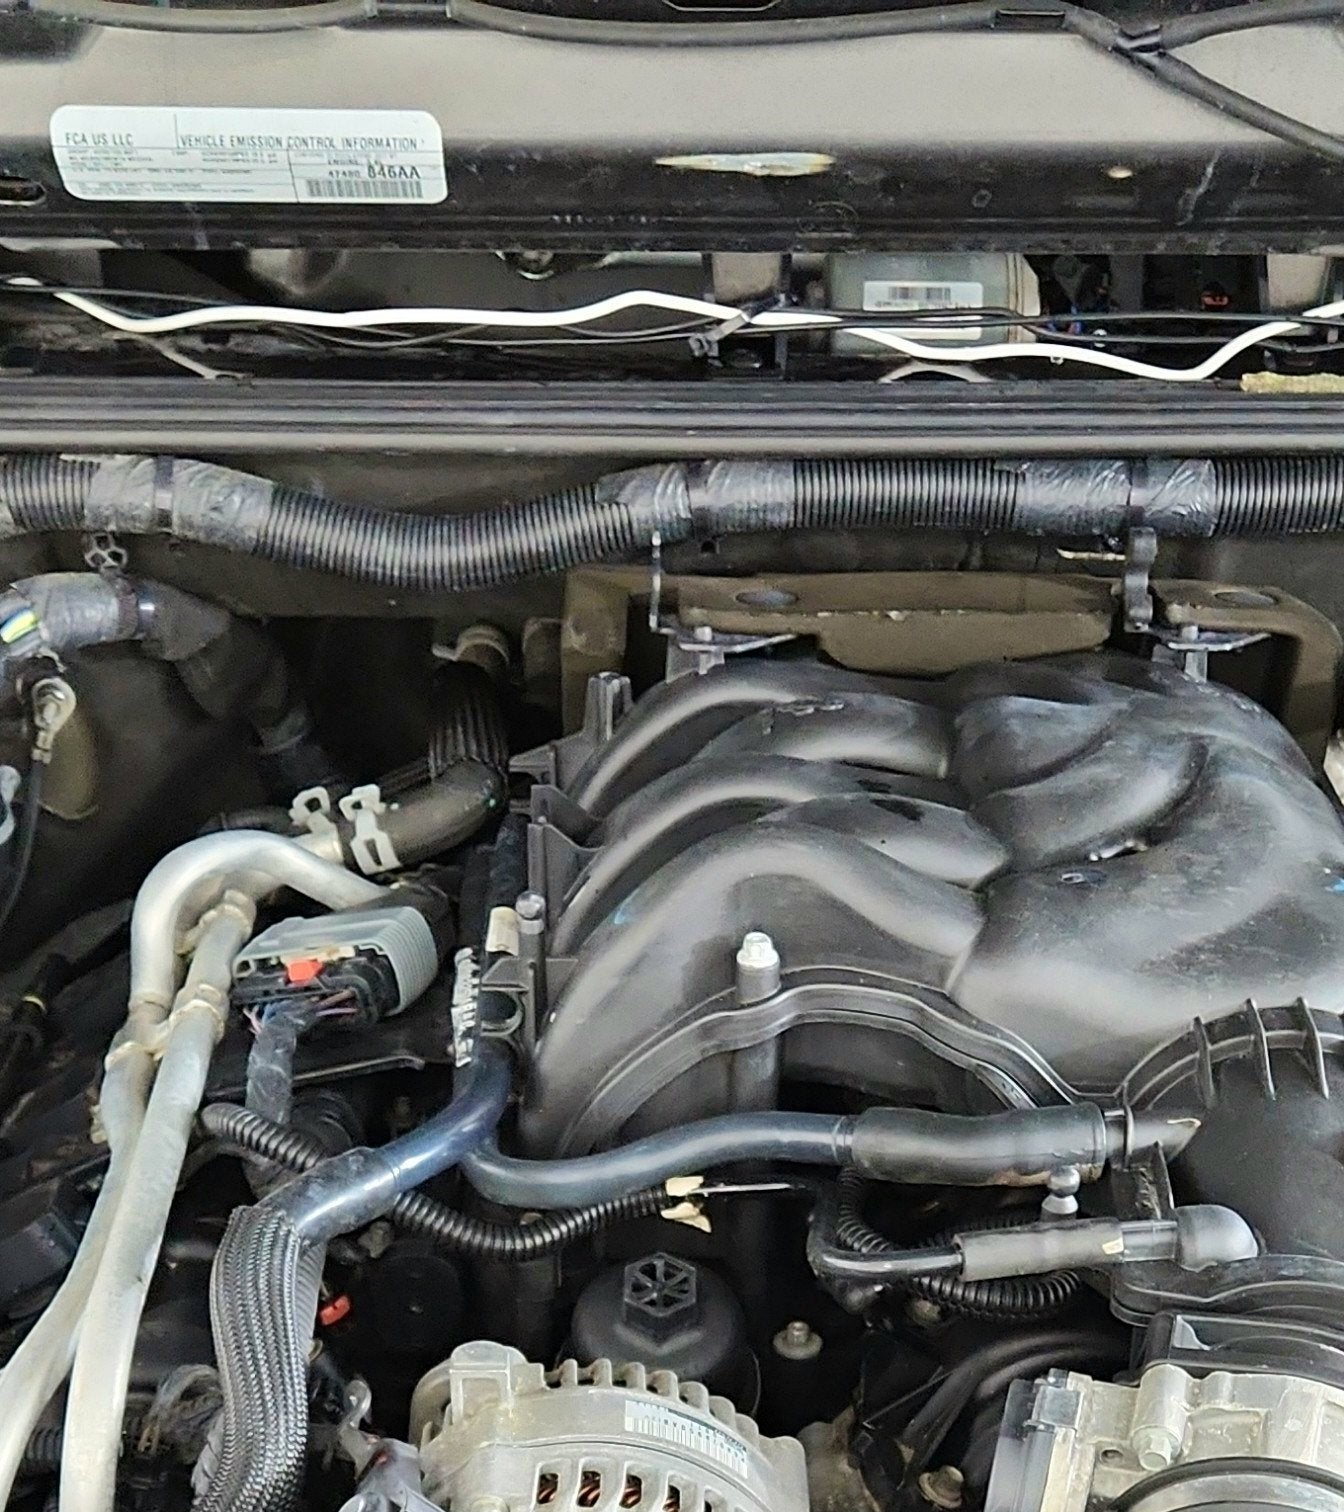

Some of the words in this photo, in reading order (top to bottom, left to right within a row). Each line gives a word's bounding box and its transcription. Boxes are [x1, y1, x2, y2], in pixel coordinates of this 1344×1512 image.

[65, 132, 88, 146] FCA
[92, 133, 108, 147] US
[112, 133, 133, 147] LLC
[180, 135, 224, 148] VEHICLE
[230, 135, 282, 149] EMISSION
[287, 136, 336, 149] CONTROL
[342, 137, 417, 150] INFORMATION
